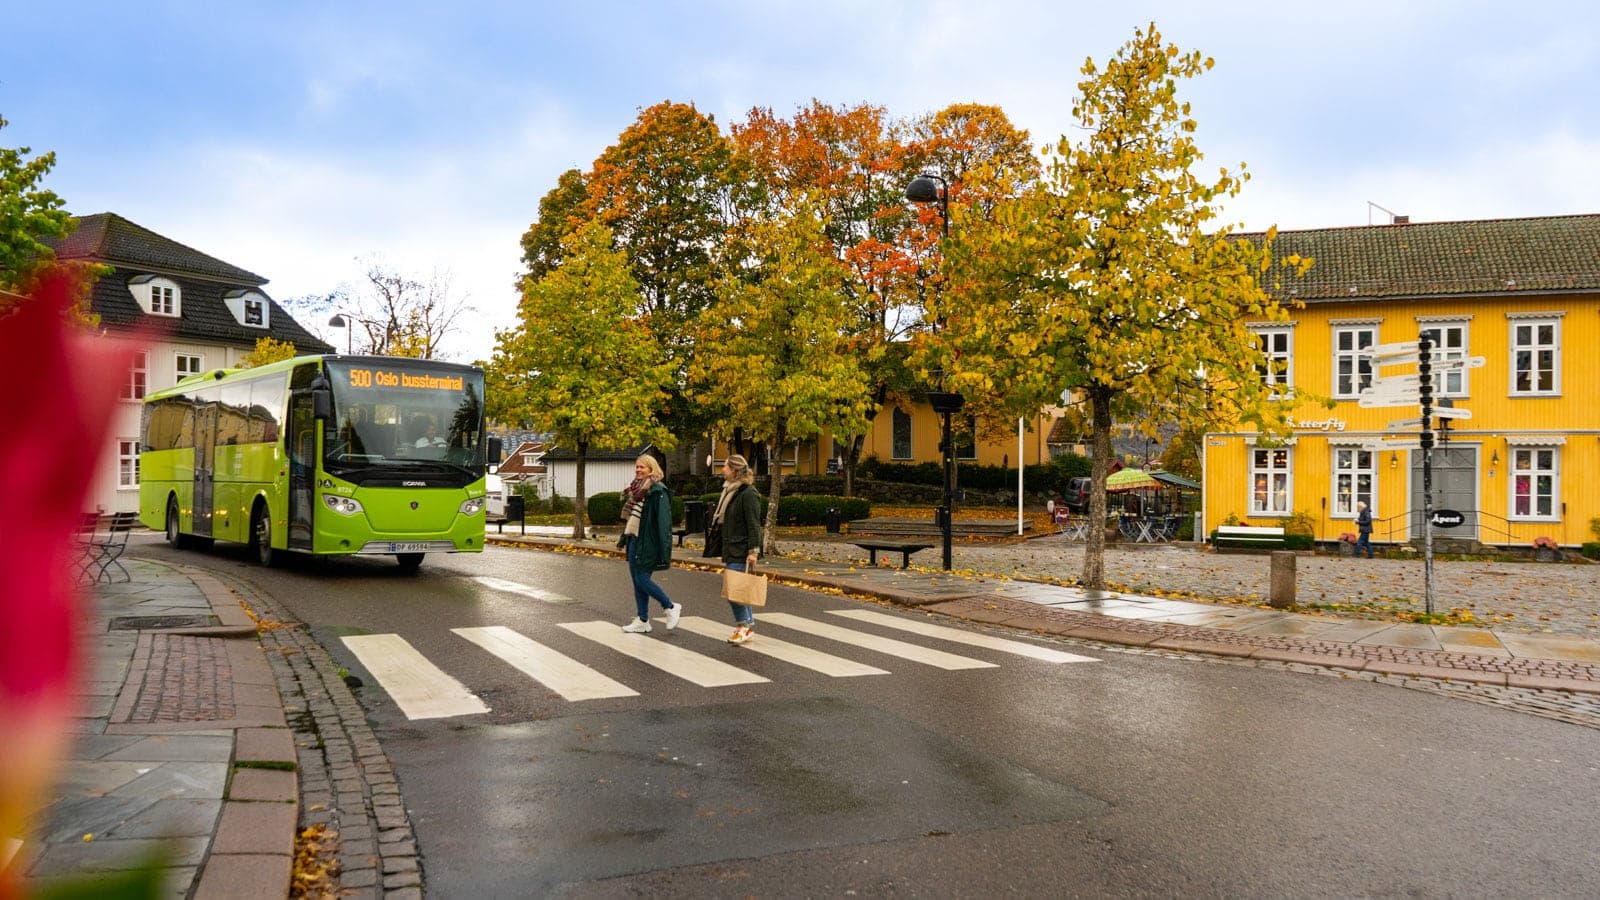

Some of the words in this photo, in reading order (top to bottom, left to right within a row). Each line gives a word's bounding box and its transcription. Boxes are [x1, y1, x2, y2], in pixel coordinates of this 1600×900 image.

[350, 369, 372, 388] 500
[375, 370, 399, 387] Oslo
[401, 373, 463, 391] bussterminal
